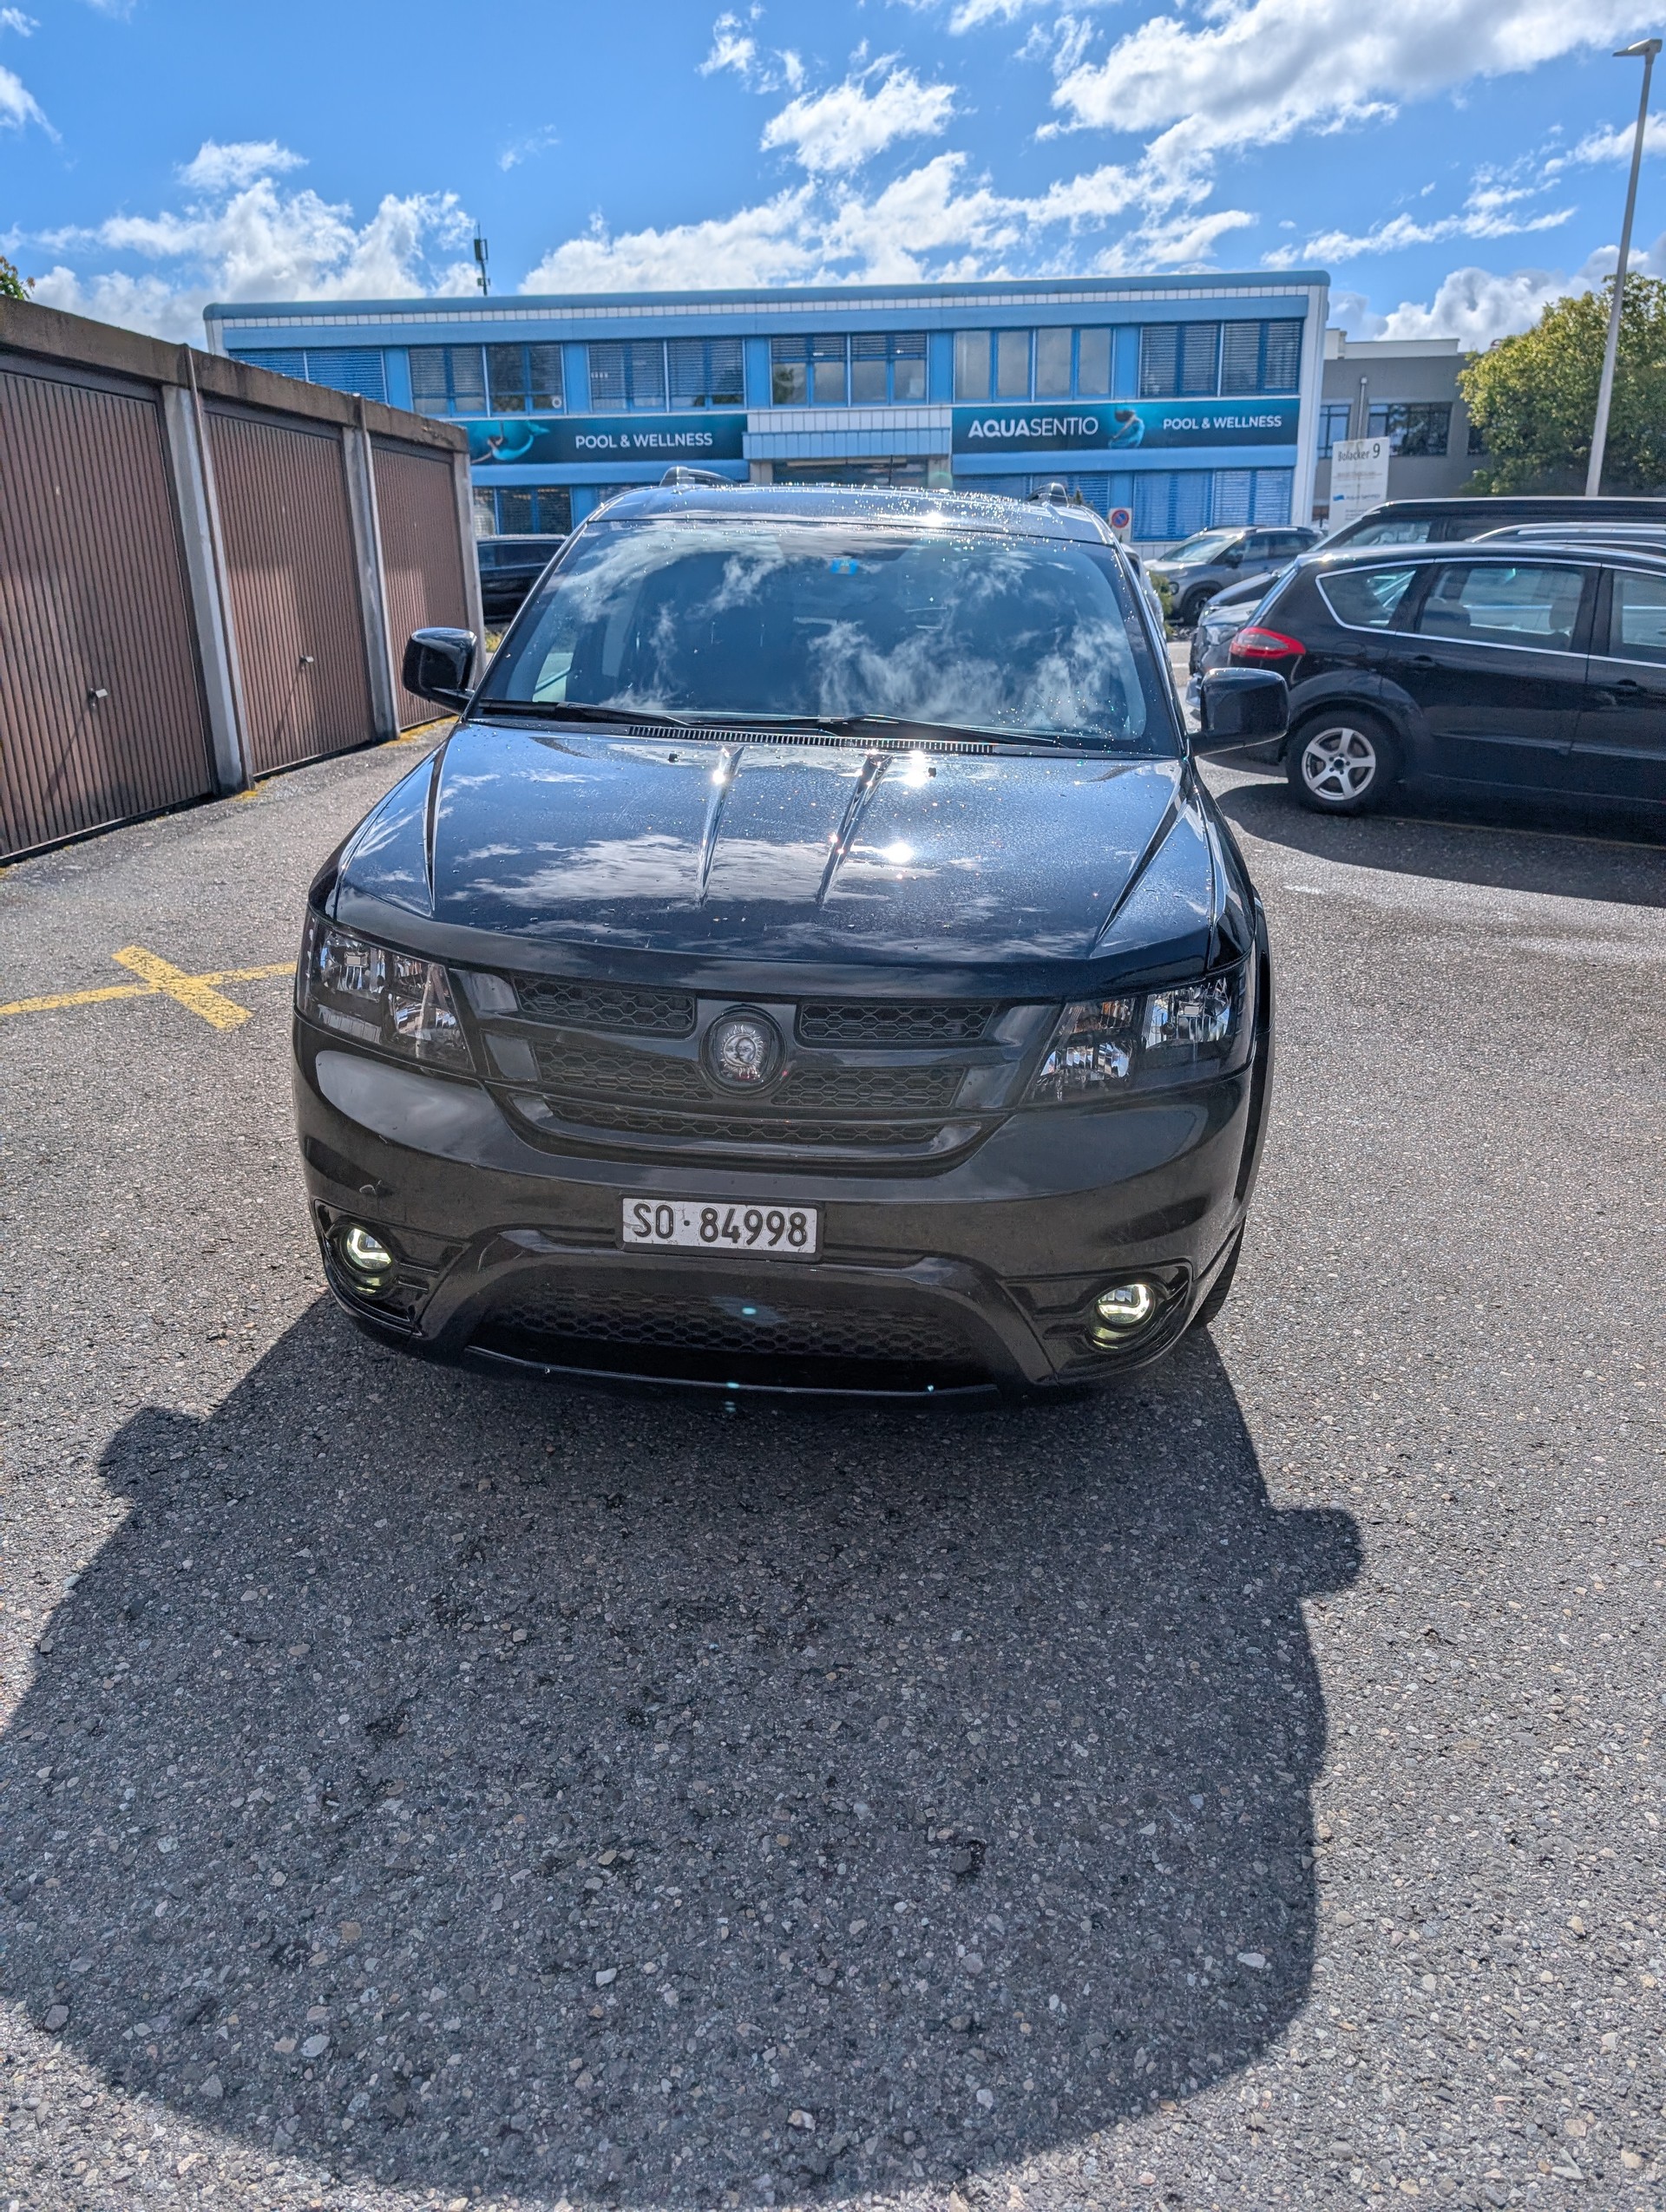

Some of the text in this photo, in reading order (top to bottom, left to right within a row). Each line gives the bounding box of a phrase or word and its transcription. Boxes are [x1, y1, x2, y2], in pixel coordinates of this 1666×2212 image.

[967, 416, 1099, 438] AQUASENTIO
[1163, 415, 1282, 430] POOL & WELLNESS
[575, 432, 713, 448] POOL & WELLNESS
[1372, 442, 1381, 459] 9
[633, 1202, 807, 1247] SO 84998
